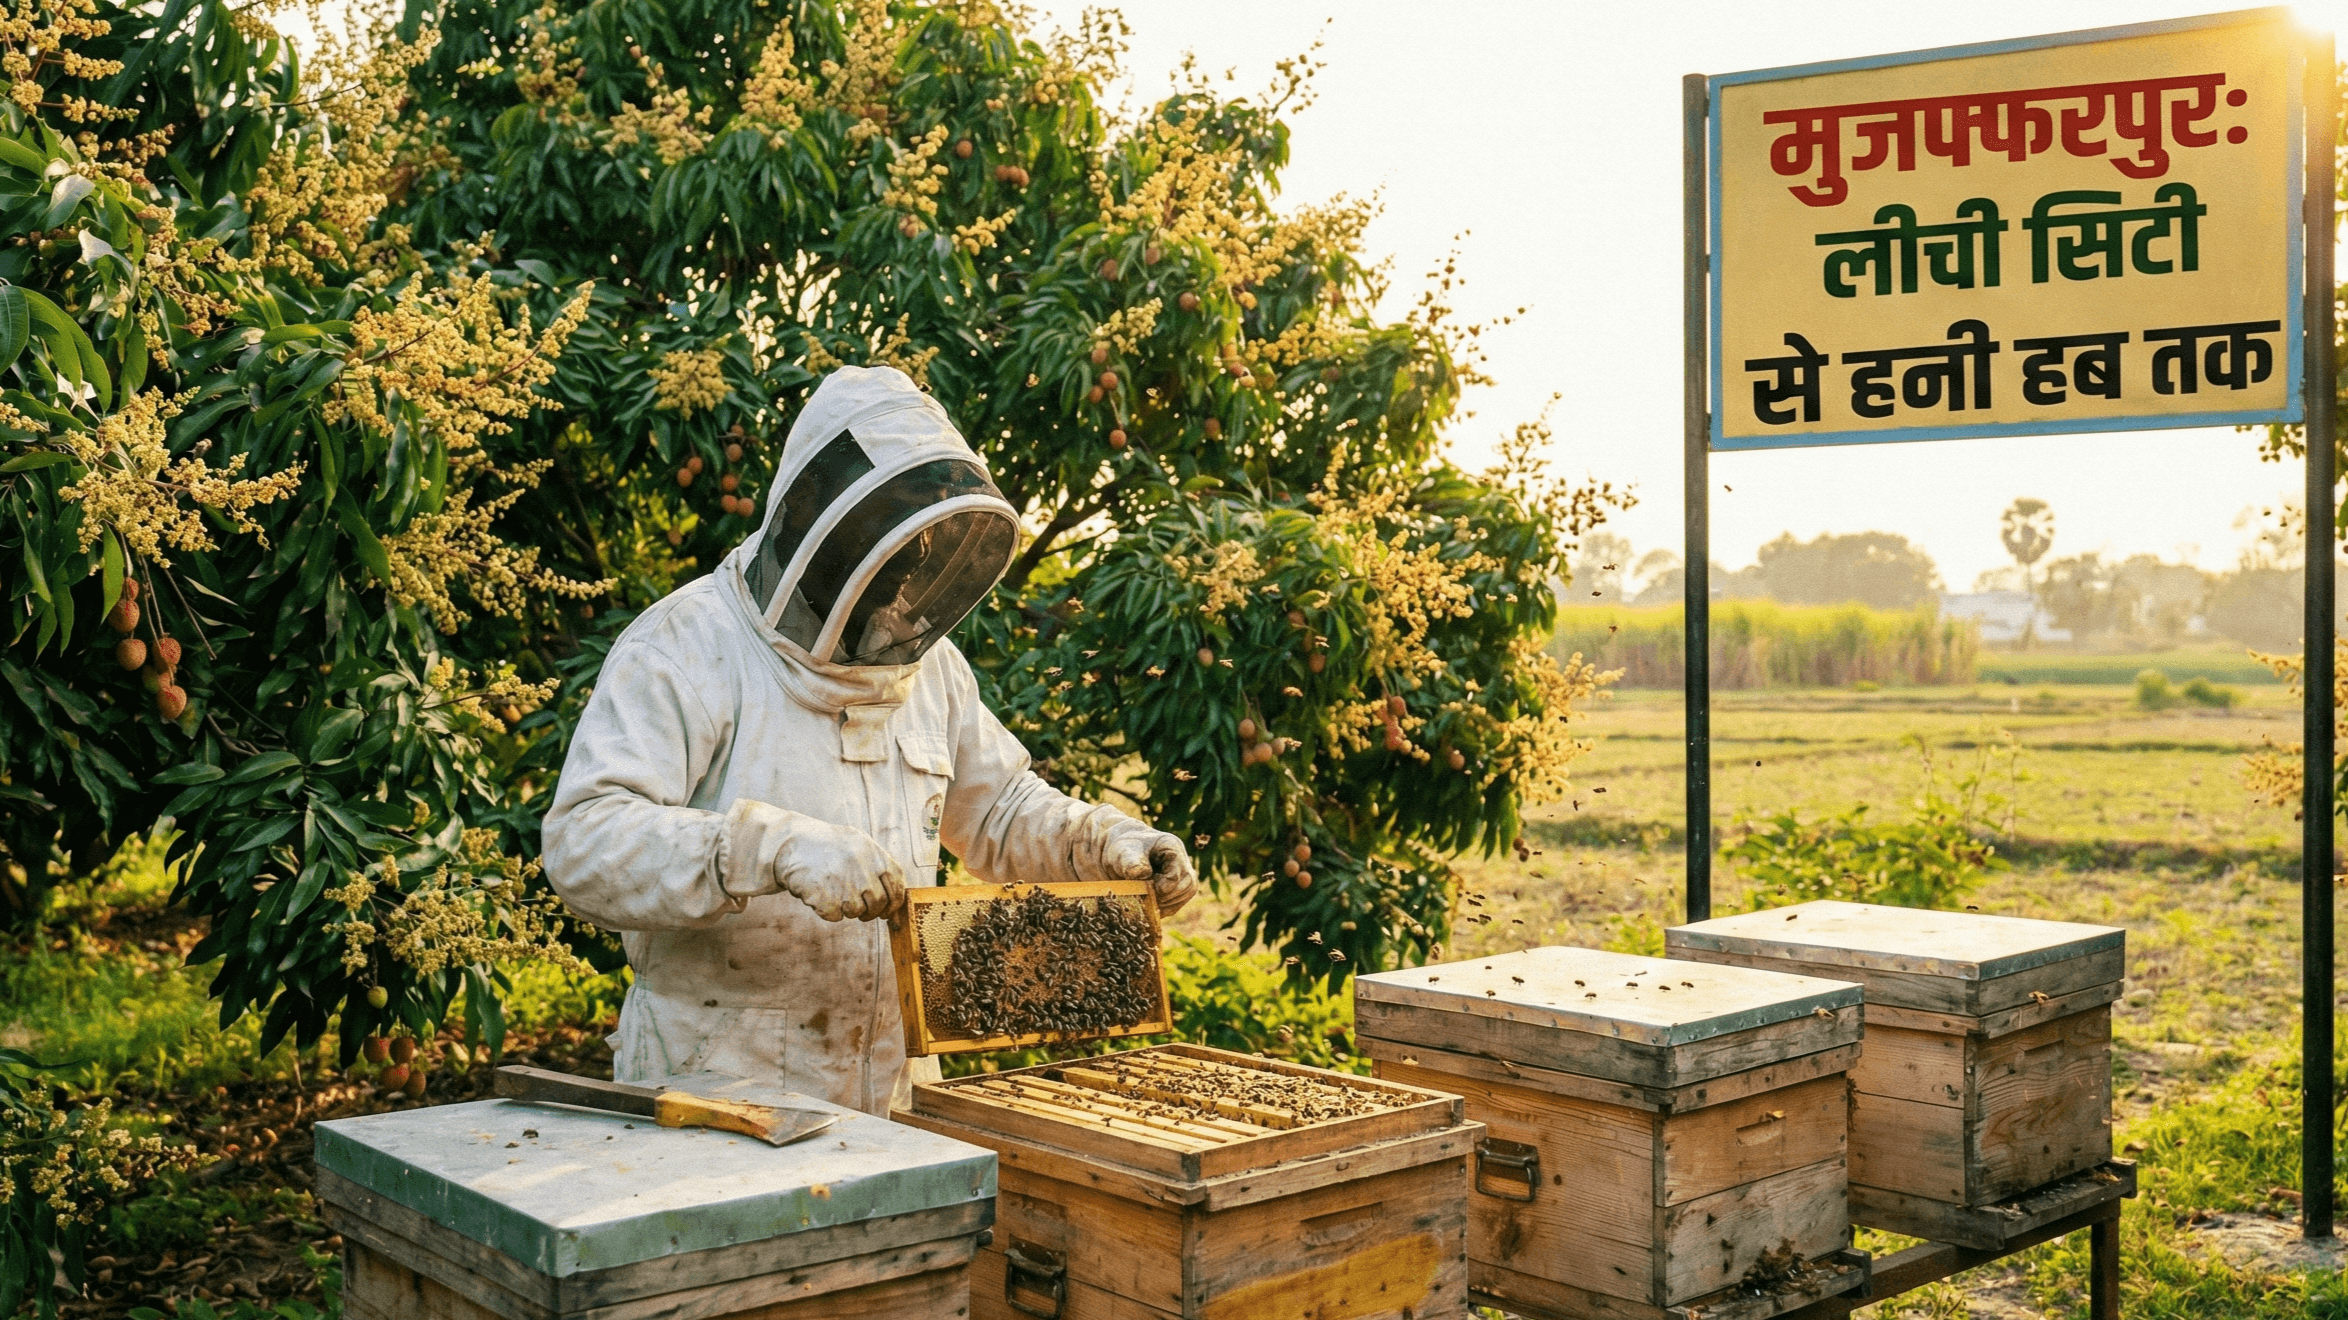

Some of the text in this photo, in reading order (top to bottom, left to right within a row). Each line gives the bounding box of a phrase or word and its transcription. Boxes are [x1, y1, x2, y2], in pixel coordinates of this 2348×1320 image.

[1814, 182, 2207, 299] लीची सिटी
[1744, 318, 2281, 426] से हनी हब तक
